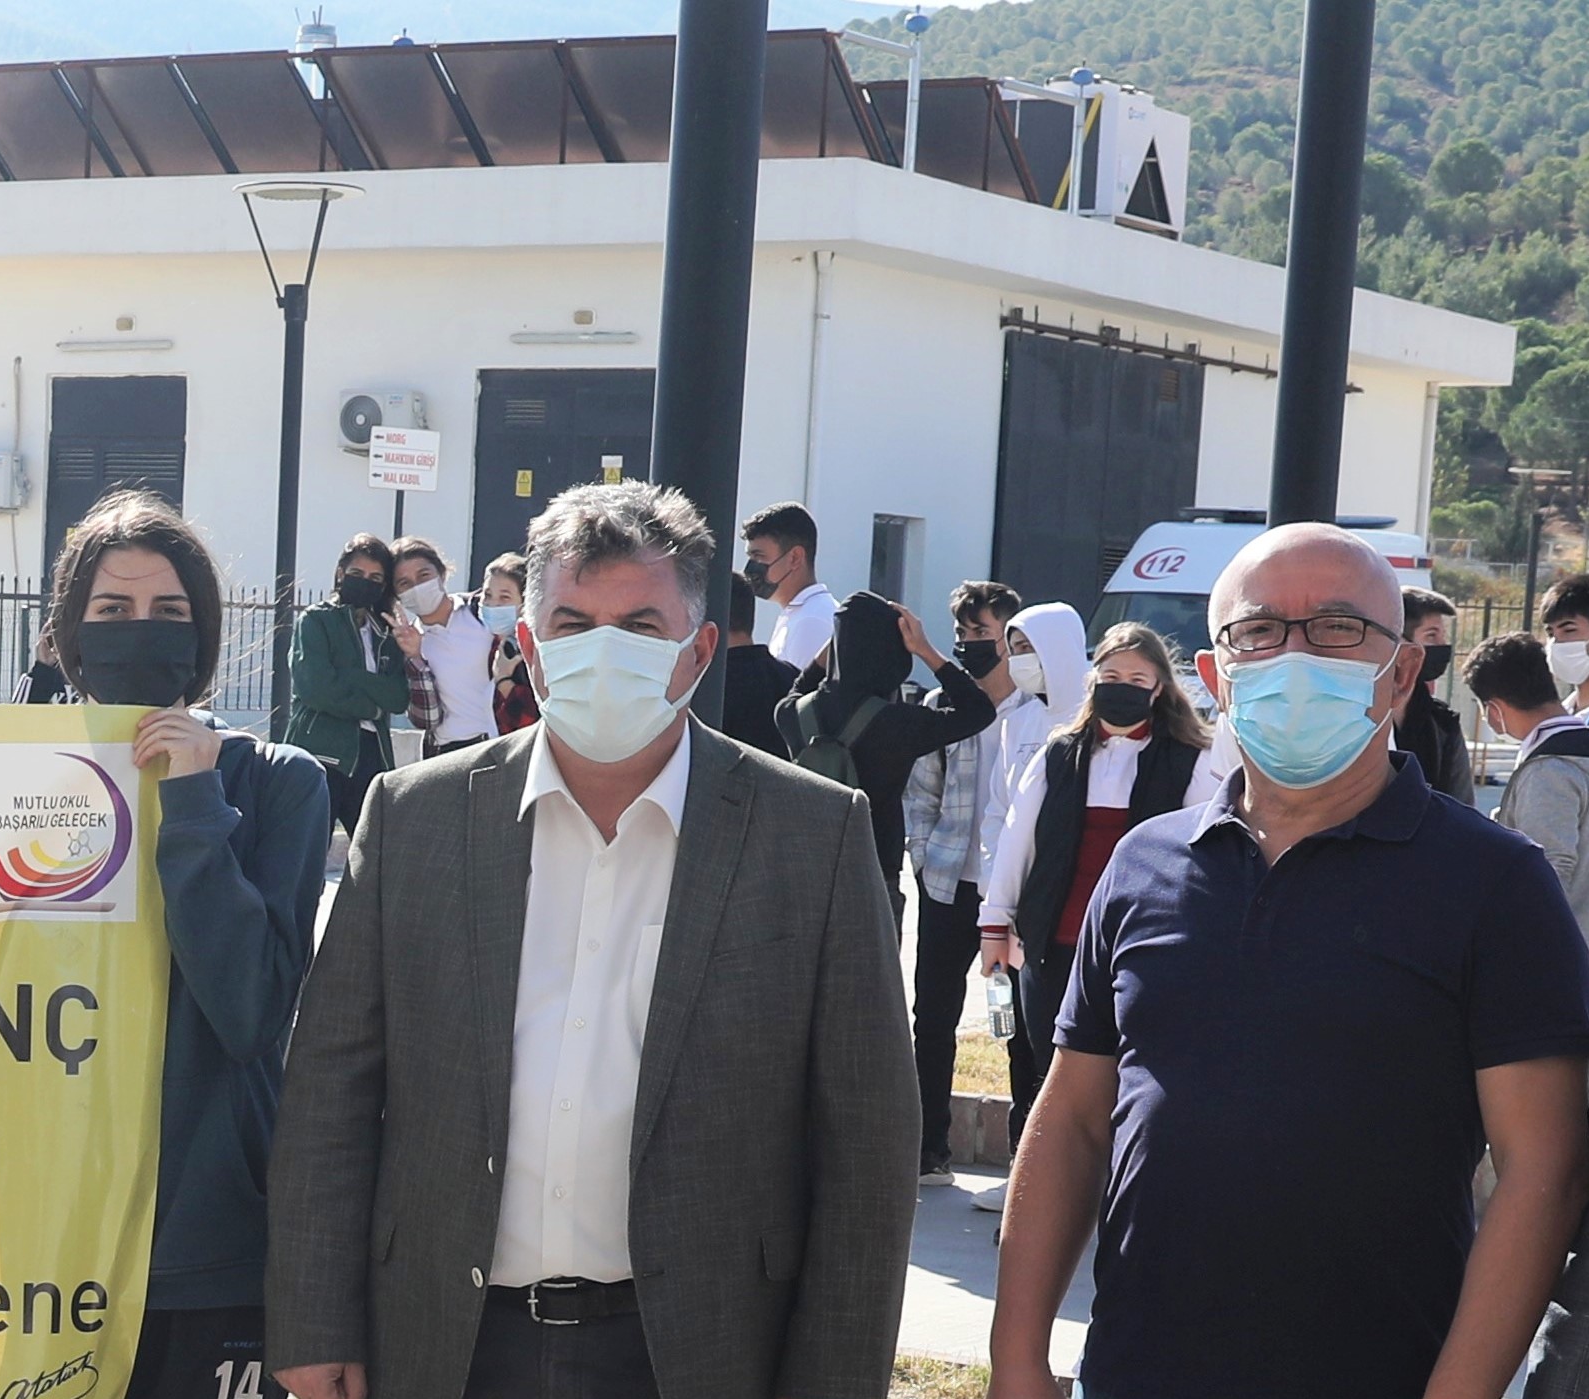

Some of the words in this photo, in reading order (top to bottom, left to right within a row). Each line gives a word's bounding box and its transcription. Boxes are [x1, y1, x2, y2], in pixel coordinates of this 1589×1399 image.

[385, 432, 406, 445] MORG
[384, 452, 415, 465] MAHKUM
[383, 471, 397, 484] MAL
[1145, 555, 1186, 573] 112
[13, 796, 58, 810] MUTLU
[59, 794, 91, 808] OKUL
[50, 812, 107, 829] GELECEK
